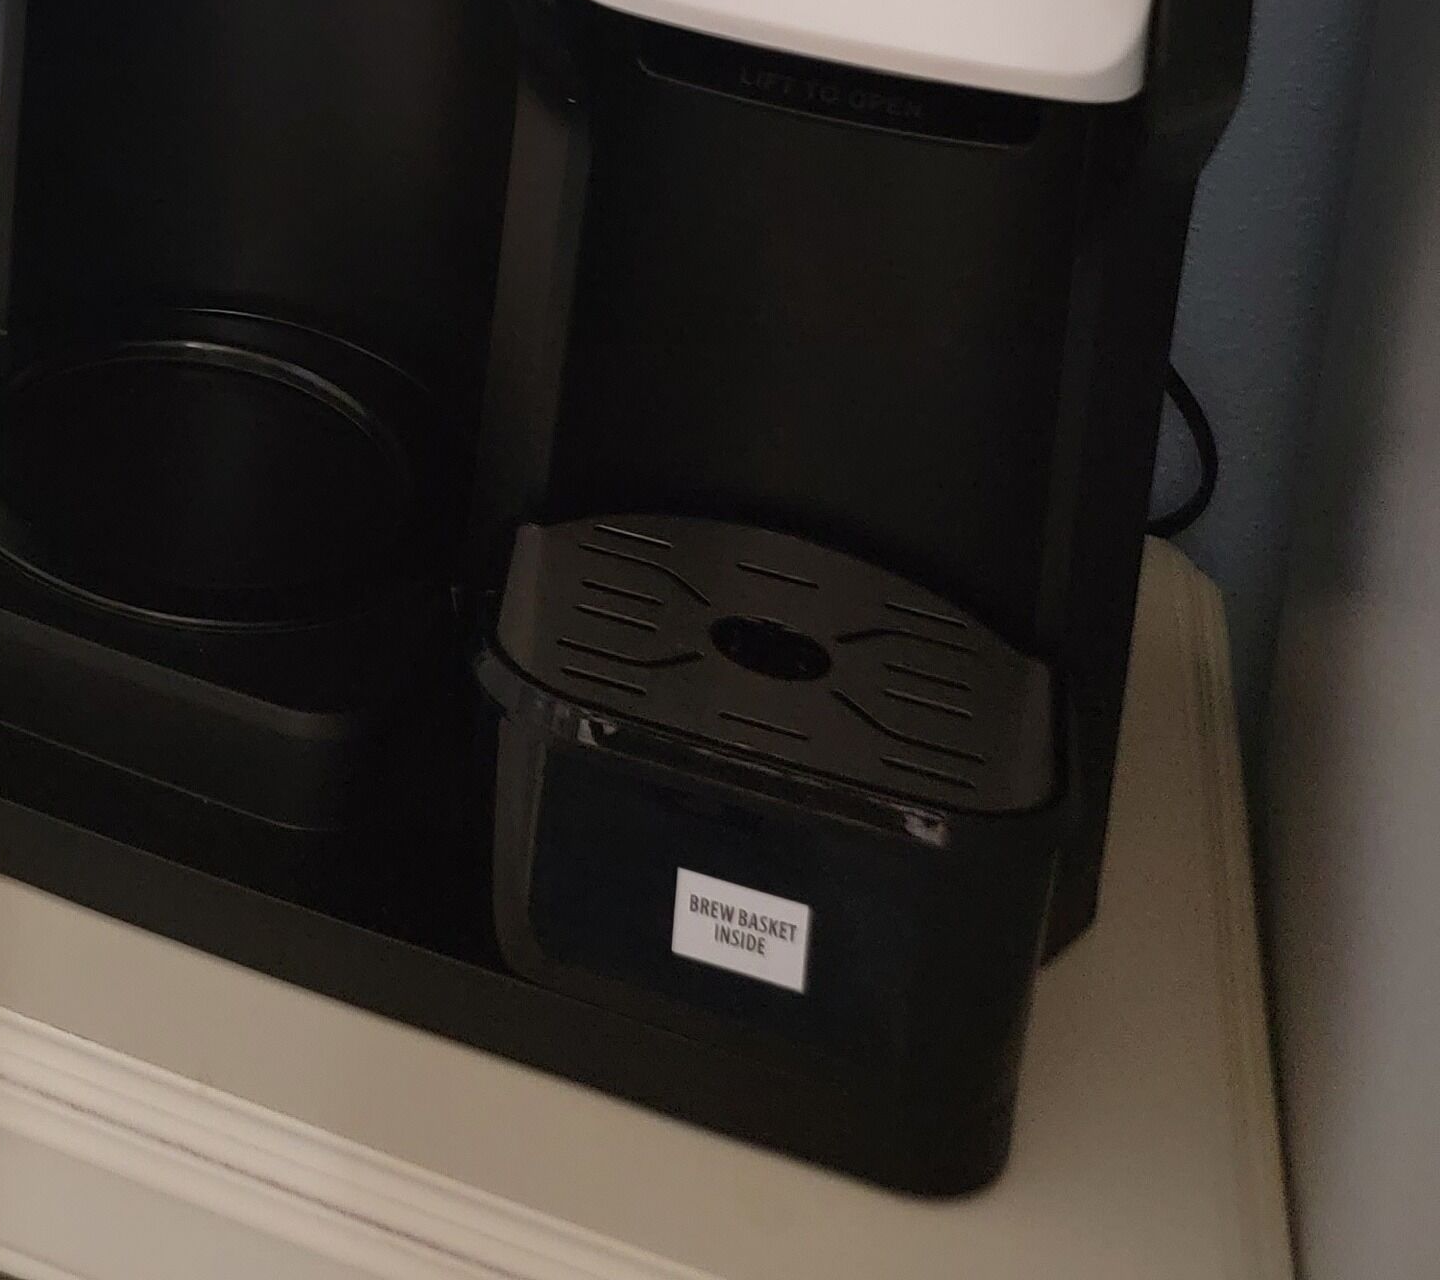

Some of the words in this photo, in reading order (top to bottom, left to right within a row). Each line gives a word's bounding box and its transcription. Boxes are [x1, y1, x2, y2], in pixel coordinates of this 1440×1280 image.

[803, 83, 841, 105] TO
[847, 92, 924, 118] OPEN
[689, 893, 735, 923] BREW
[738, 908, 797, 943] BASKET
[714, 923, 766, 955] INSIDE
